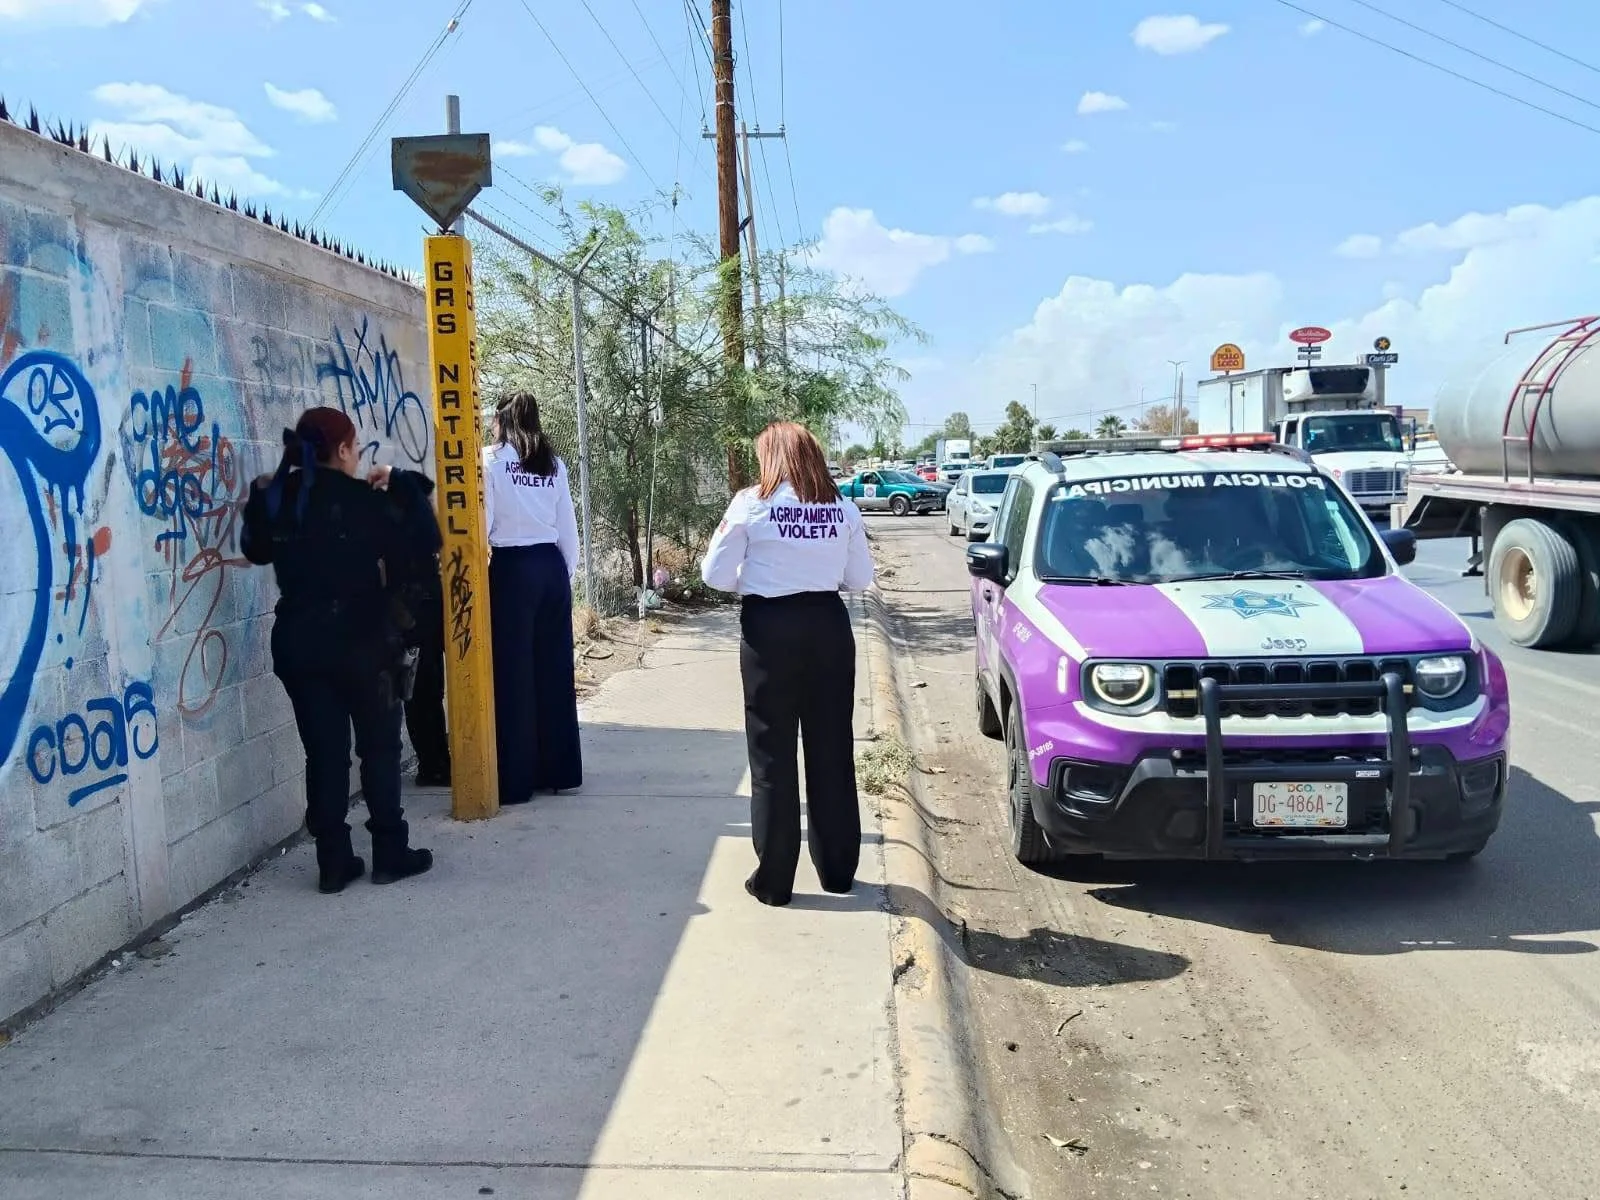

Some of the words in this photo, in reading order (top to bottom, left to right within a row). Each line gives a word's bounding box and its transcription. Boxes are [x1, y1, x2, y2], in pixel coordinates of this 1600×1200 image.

[464, 264, 473, 311] NO
[434, 261, 456, 334] GAS
[439, 364, 468, 534] NATURAL
[511, 474, 555, 488] VIOLETA
[769, 507, 844, 524] AGRUPAMIENTO
[777, 524, 838, 539] VIOLETA
[1261, 637, 1308, 652] Jeep
[1258, 795, 1345, 813] DG-486A-2
